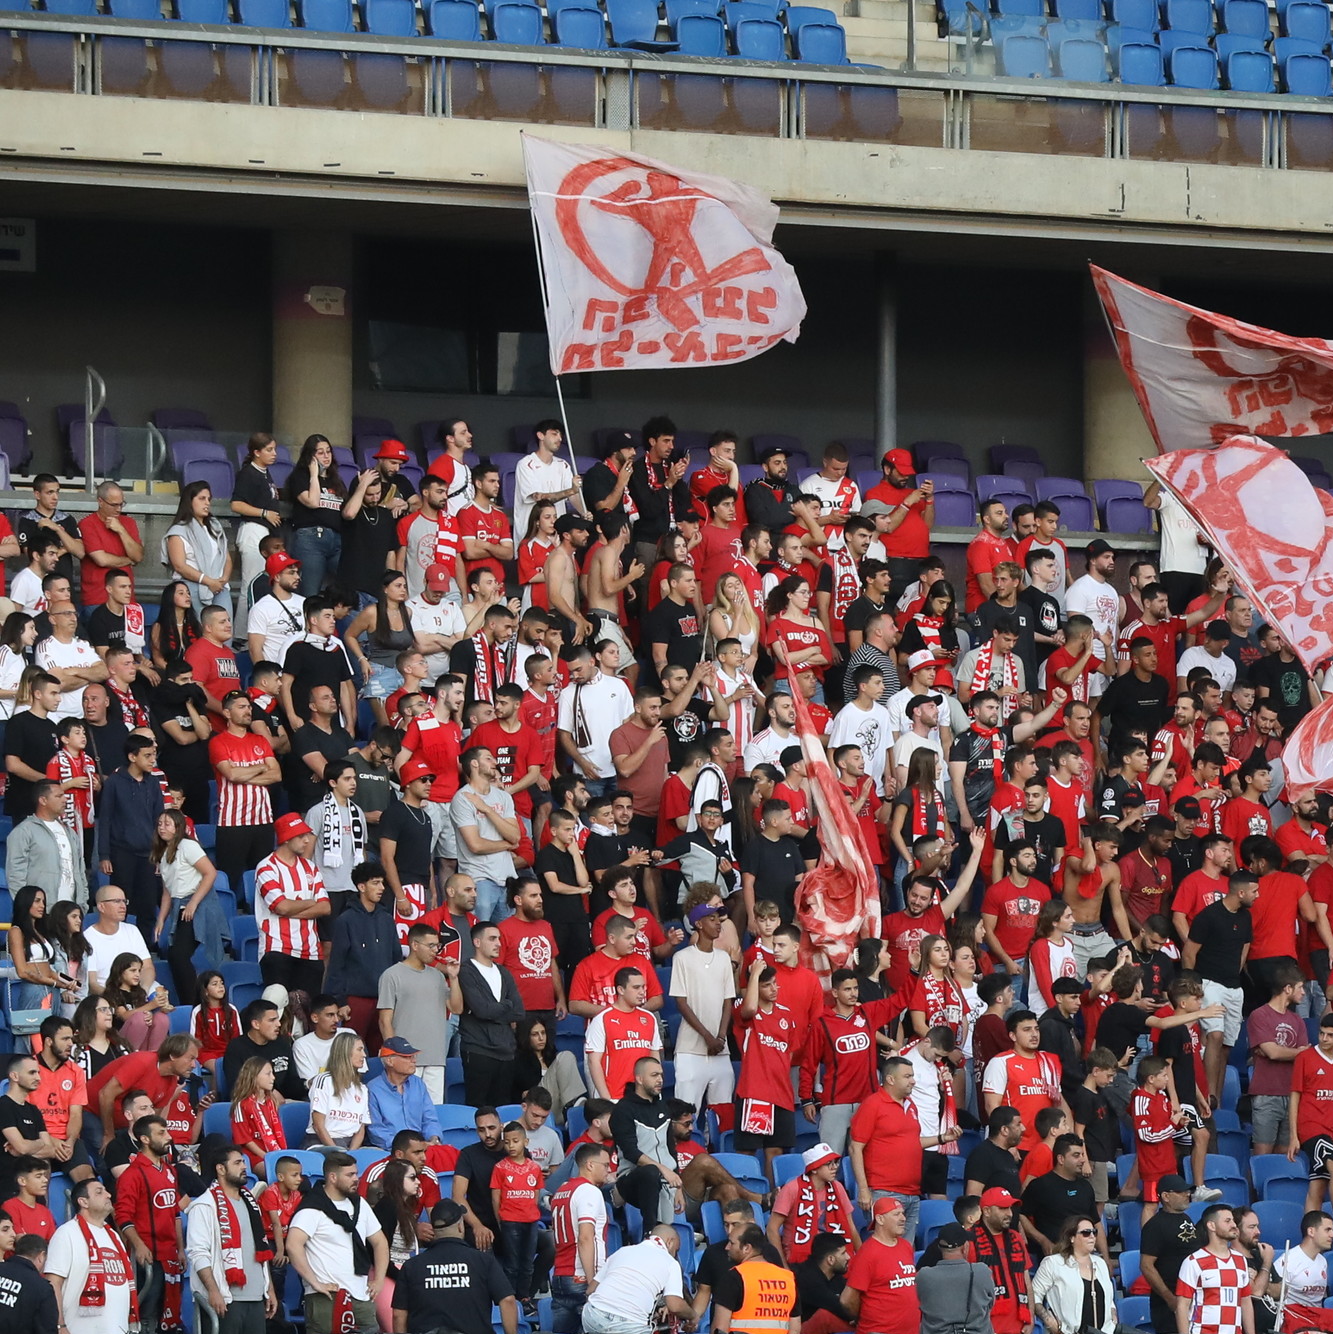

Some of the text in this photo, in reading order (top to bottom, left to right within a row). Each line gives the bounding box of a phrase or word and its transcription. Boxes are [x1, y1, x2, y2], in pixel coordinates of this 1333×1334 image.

[497, 746, 509, 755] ONE
[331, 802, 341, 850] NTI
[627, 1030, 640, 1040] Fly
[329, 1109, 358, 1120] הכשרה
[216, 1188, 232, 1244] HAPOEL
[551, 1204, 569, 1244] 11
[103, 1259, 125, 1274] RON
[427, 1262, 469, 1275] מטאור
[424, 1276, 471, 1289] אבטחה
[758, 1279, 787, 1291] סדרן
[758, 1292, 789, 1305] מטאור
[1223, 1287, 1235, 1304] 10
[754, 1306, 790, 1319] אבטחה
